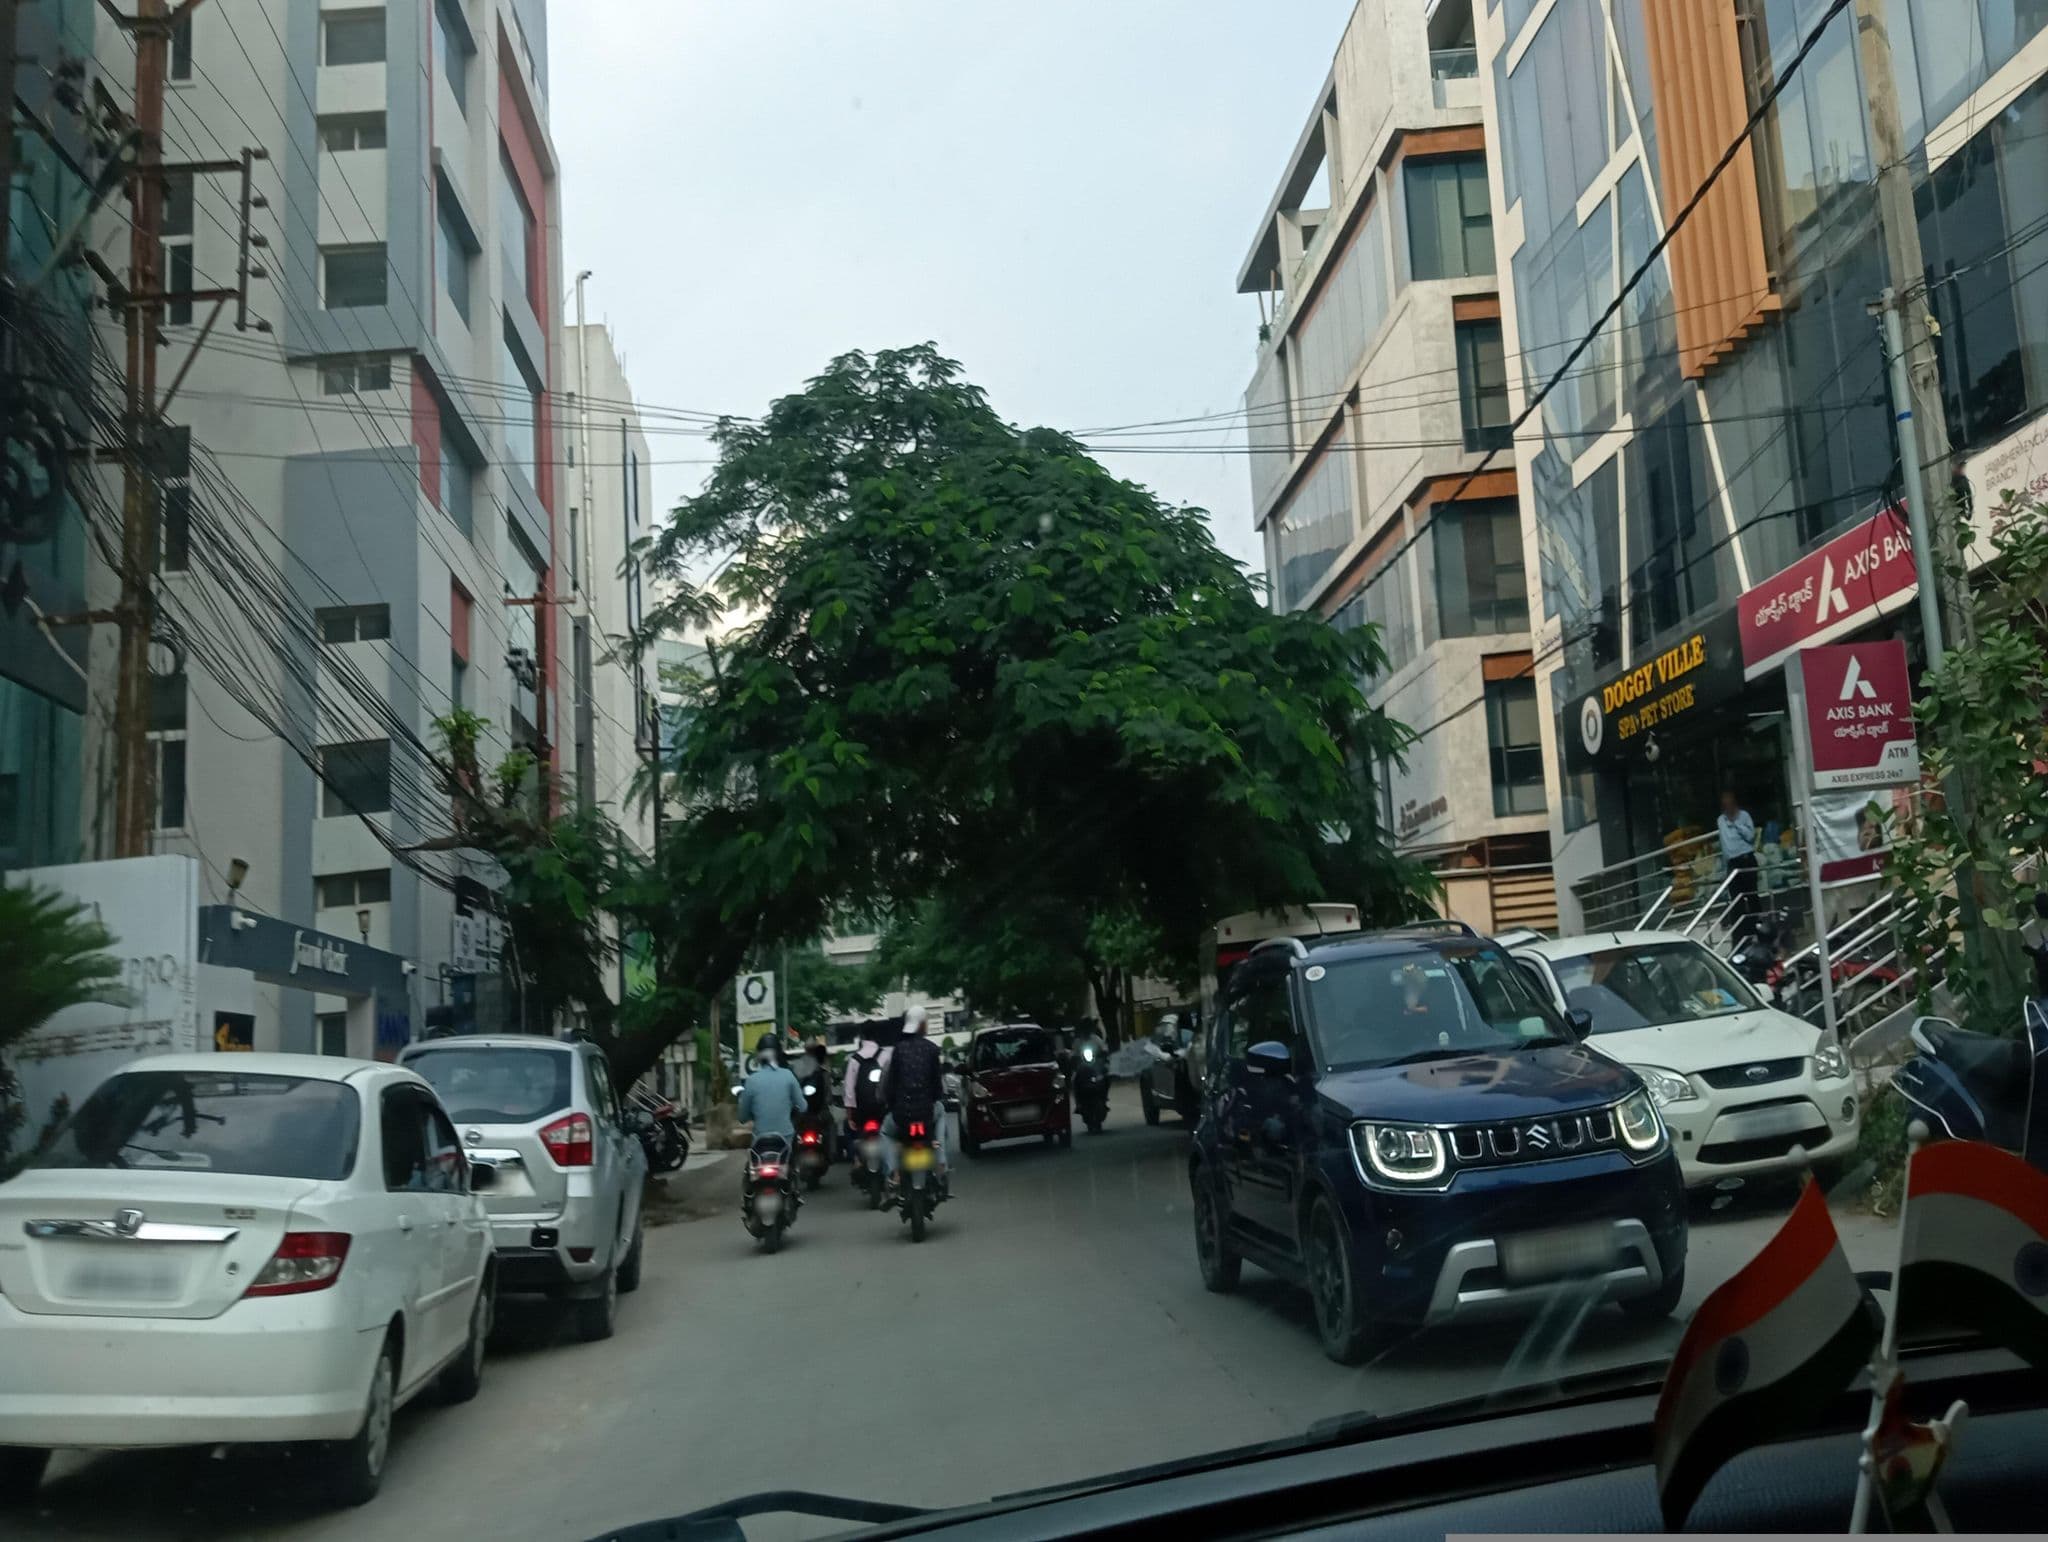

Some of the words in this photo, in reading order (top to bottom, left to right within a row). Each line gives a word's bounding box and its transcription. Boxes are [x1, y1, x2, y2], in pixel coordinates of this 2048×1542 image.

[1844, 543, 1880, 584] AXIS
[1602, 663, 1654, 715] DOGGY
[1655, 634, 1705, 684] VILLE
[1617, 714, 1637, 740] SPA
[1639, 707, 1659, 730] PET
[1660, 684, 1695, 720] STORE
[1826, 706, 1855, 721] AXIS
[1858, 703, 1894, 719] BANK
[1887, 746, 1909, 760] ATM
[1831, 774, 1849, 784] AXIS
[1850, 771, 1886, 783] EXPRESS
